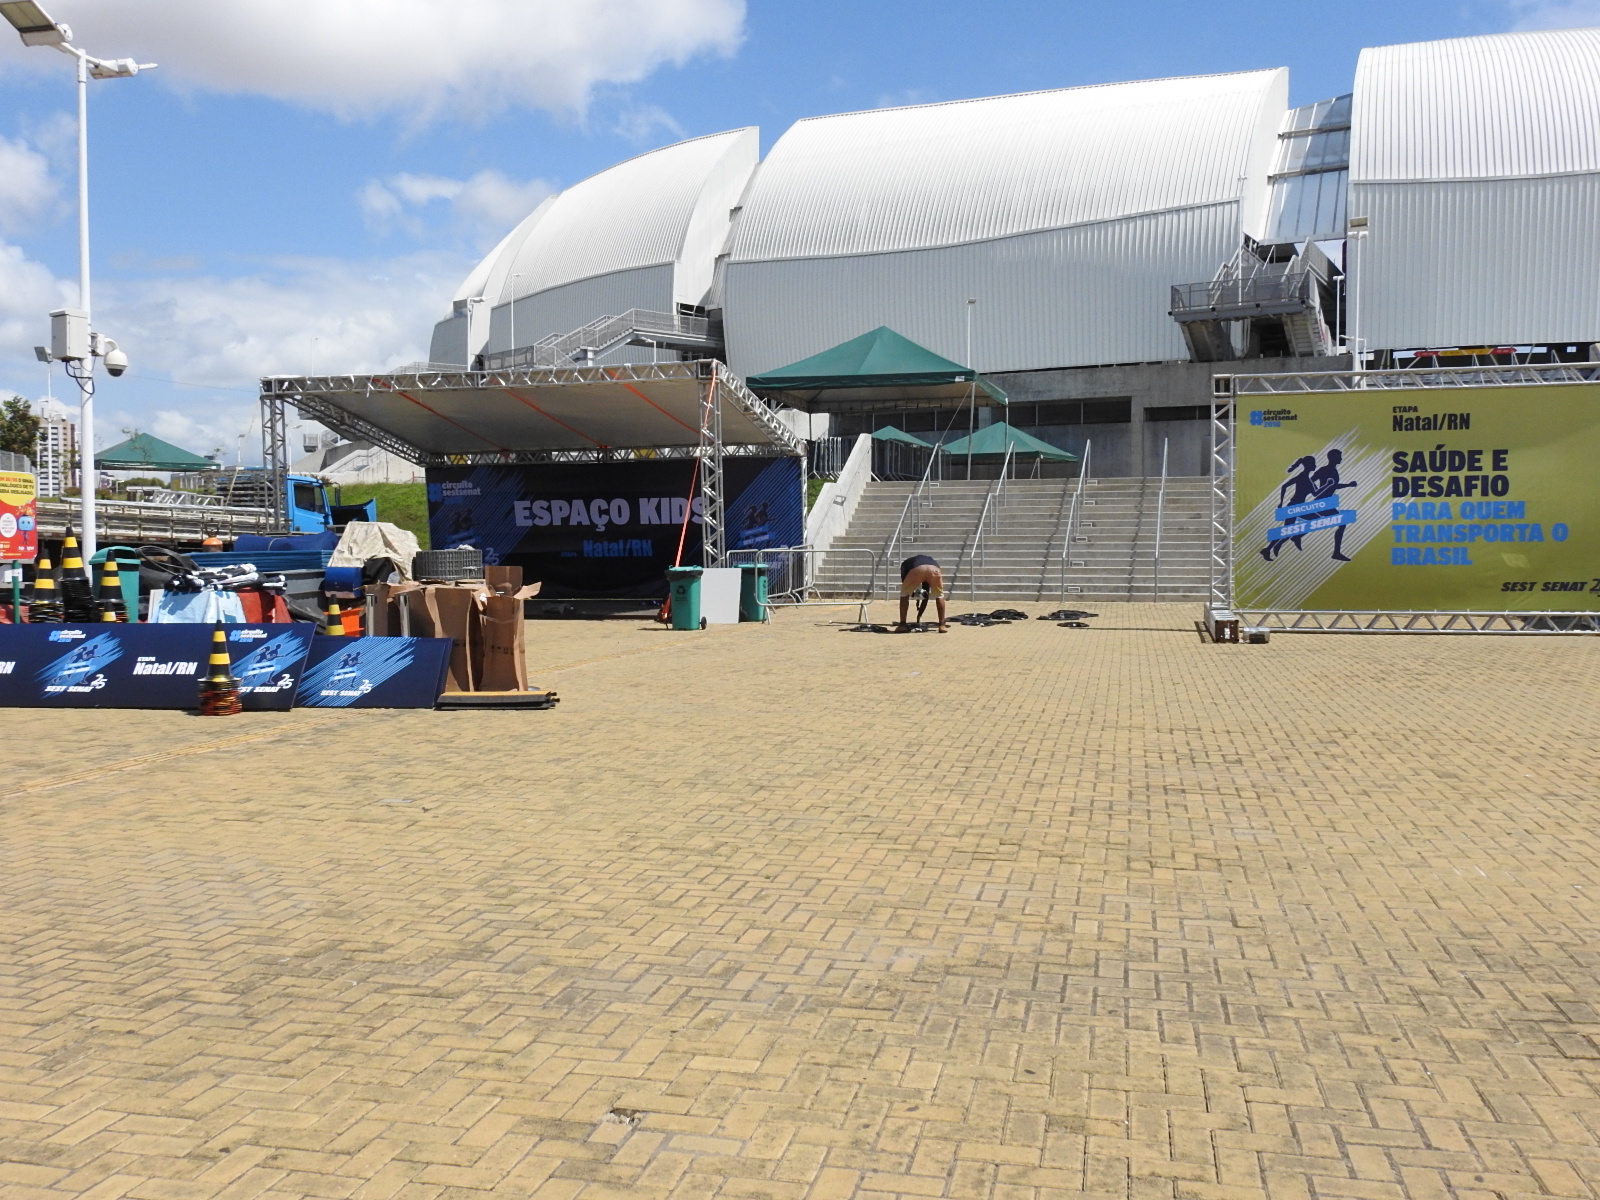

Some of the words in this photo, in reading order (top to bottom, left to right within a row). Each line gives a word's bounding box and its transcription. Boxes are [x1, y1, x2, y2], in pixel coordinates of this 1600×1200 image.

[1392, 406, 1418, 418] ETAPA
[1392, 412, 1470, 432] Natal/RN
[1392, 444, 1483, 473] SAÚDE
[1492, 449, 1508, 472] E
[441, 480, 472, 489] circuito
[442, 487, 481, 497] sestsenat
[1392, 474, 1510, 498] DESAFIO
[514, 498, 631, 532] ESPAÇO
[1287, 501, 1326, 515] CIRCUITO
[1391, 501, 1453, 521] PARA
[1459, 500, 1527, 521] QUEM
[1280, 522, 1307, 537] SEST
[1309, 514, 1343, 530] SENAT
[1391, 523, 1545, 543] TRANSPORTA
[1551, 522, 1569, 542] O
[583, 538, 653, 558] Natal/RN
[1390, 546, 1473, 566] BRASIL
[1500, 581, 1537, 592] SEST
[1540, 581, 1588, 592] SENAT
[132, 662, 198, 676] Natal/RN
